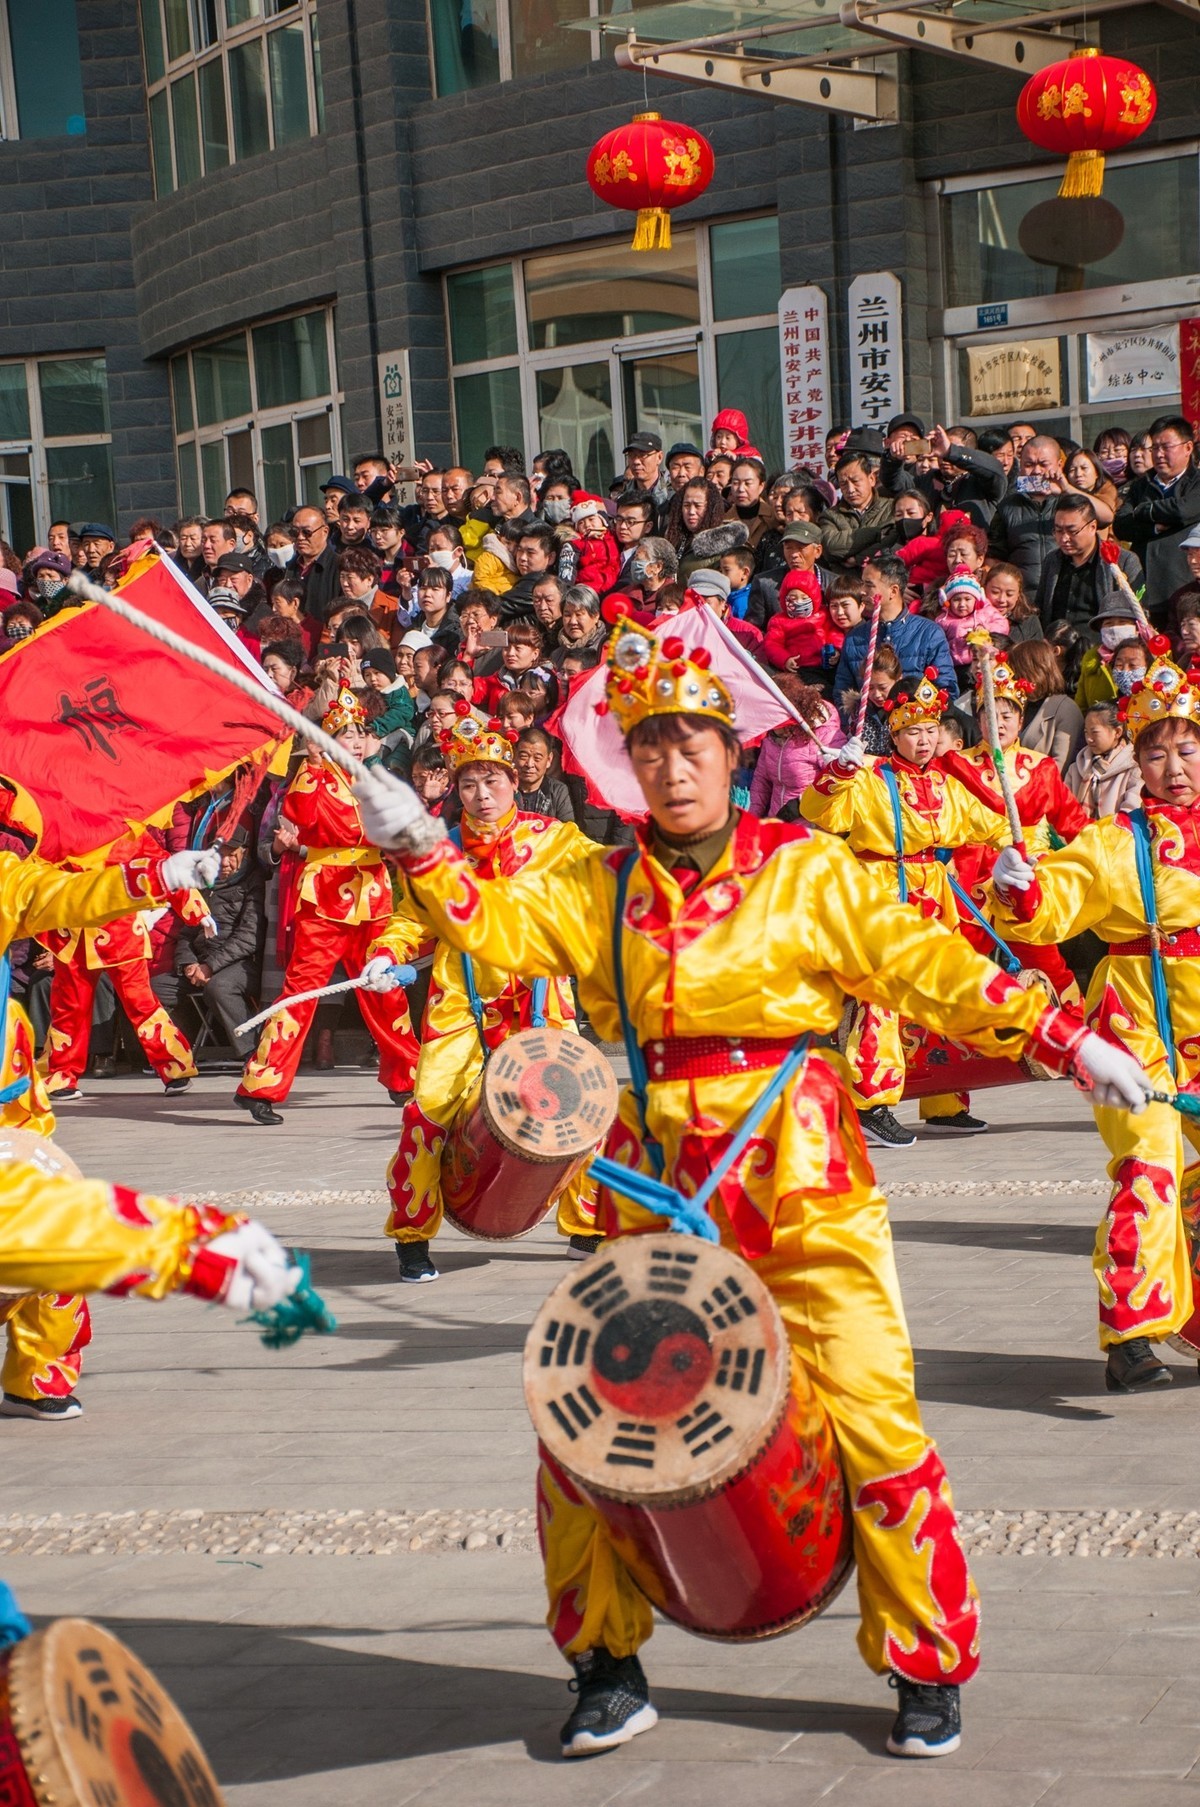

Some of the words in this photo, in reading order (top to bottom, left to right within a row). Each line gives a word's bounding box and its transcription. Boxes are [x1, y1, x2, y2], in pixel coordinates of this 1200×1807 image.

[783, 311, 802, 405] 兰州市安宁区
[804, 308, 823, 403] 中国共产党
[1108, 369, 1165, 387] 综治中心
[386, 405, 396, 445] 安宁区
[395, 403, 405, 443] 兰州市
